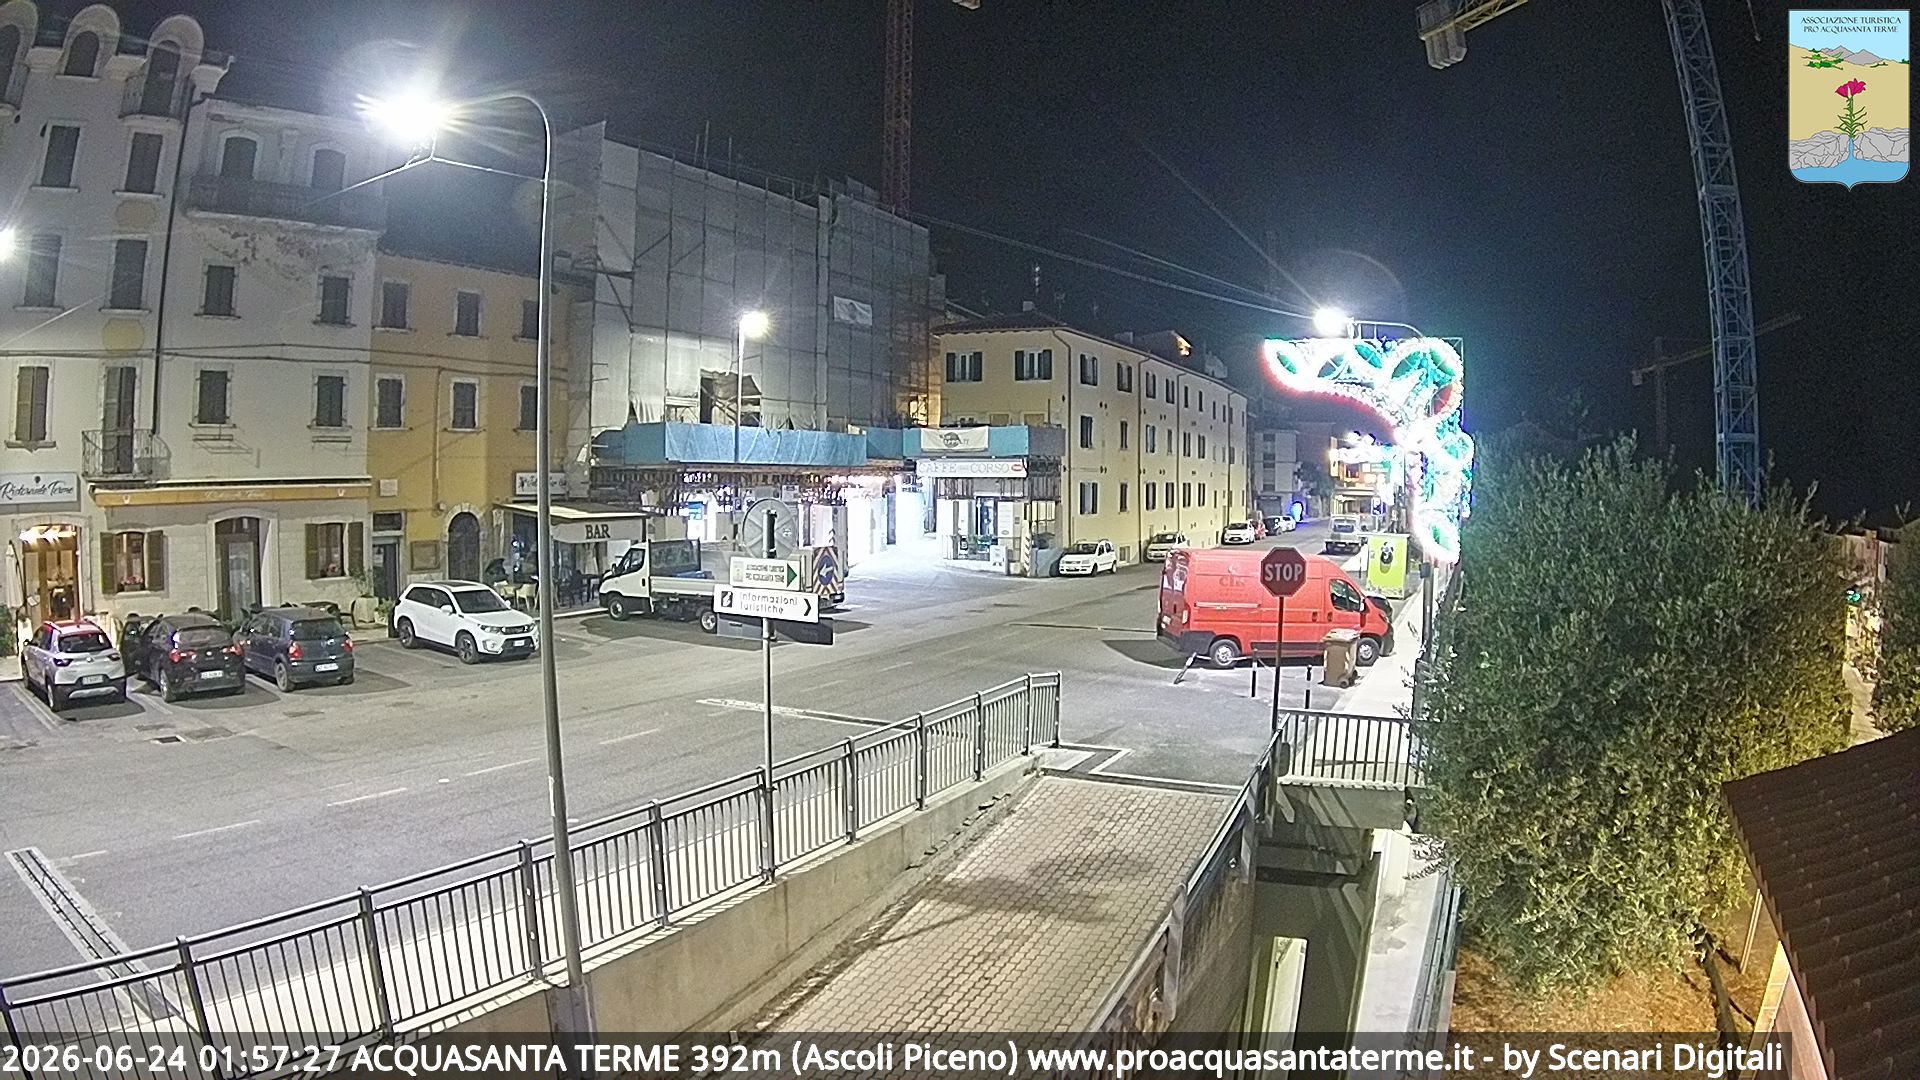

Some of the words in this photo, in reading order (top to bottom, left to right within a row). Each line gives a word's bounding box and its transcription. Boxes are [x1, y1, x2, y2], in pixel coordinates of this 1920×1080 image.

[970, 462, 1010, 473] CORSO
[585, 523, 611, 540] BAR
[1264, 563, 1303, 582] STOP
